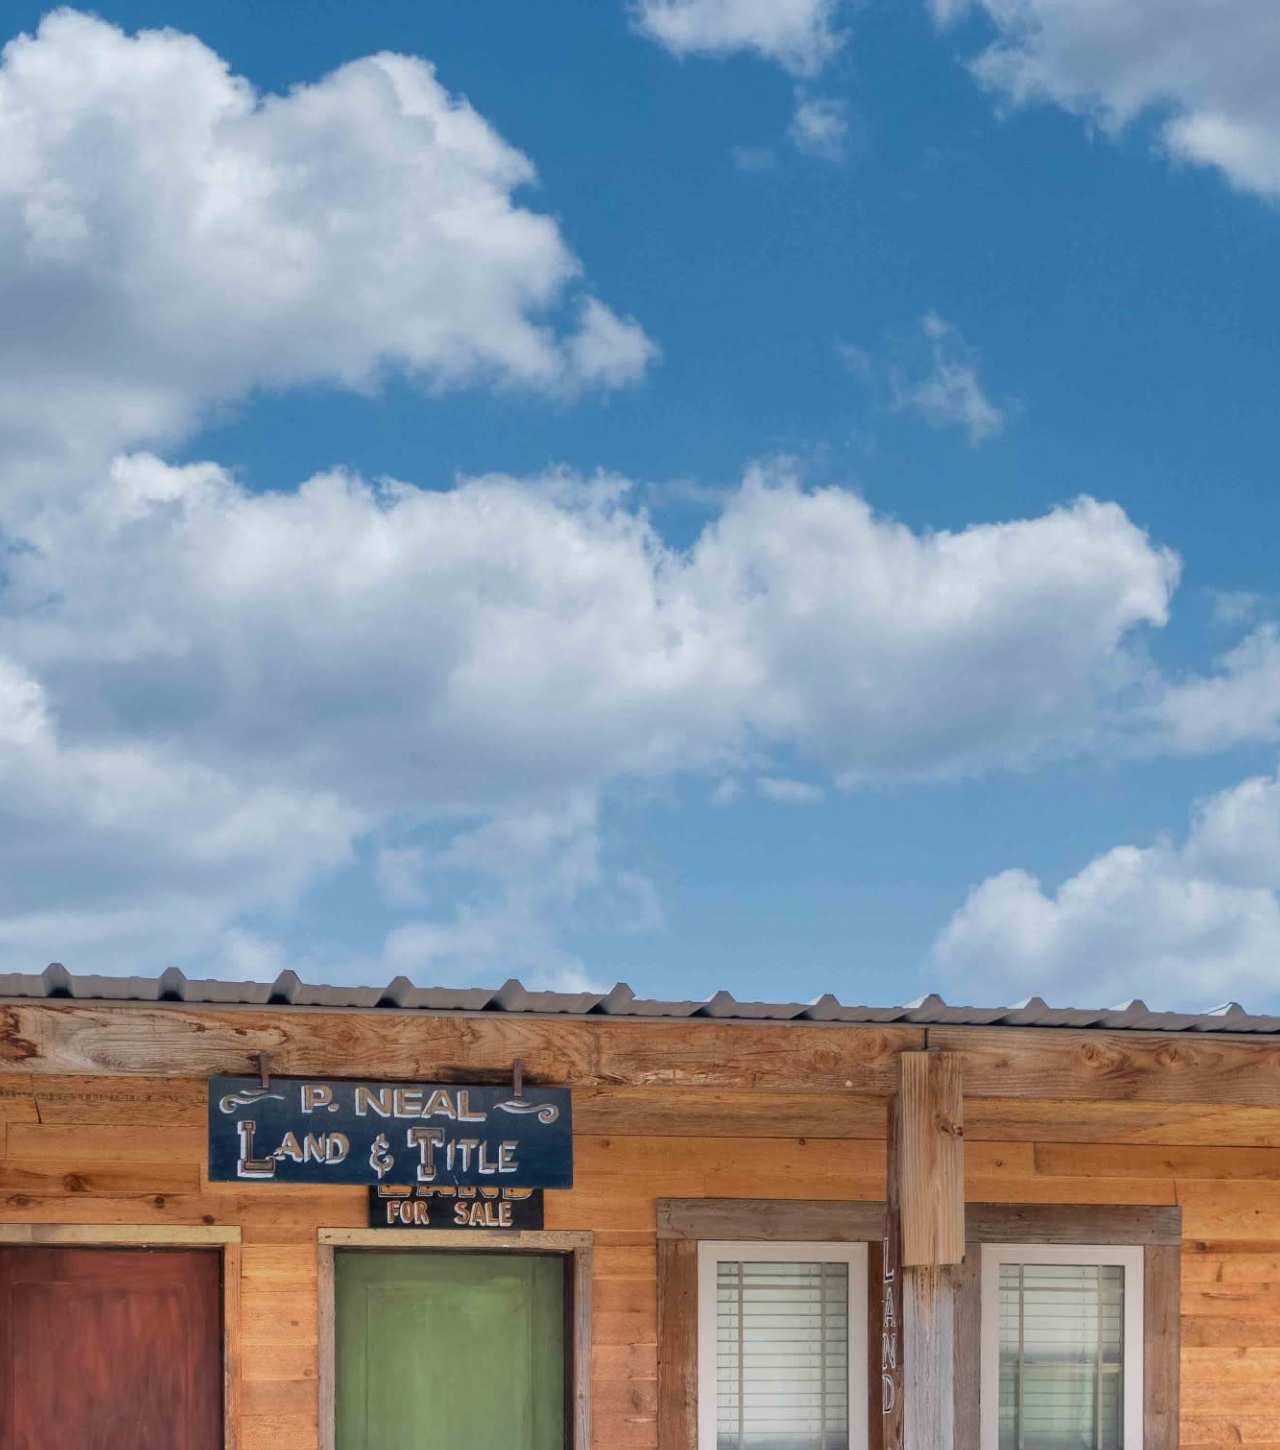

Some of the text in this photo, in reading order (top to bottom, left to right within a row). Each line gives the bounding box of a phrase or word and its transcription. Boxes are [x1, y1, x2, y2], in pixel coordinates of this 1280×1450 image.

[301, 1085, 487, 1121] P. NEAL
[369, 1133, 394, 1179] &
[386, 1200, 513, 1227] FOR SALE
